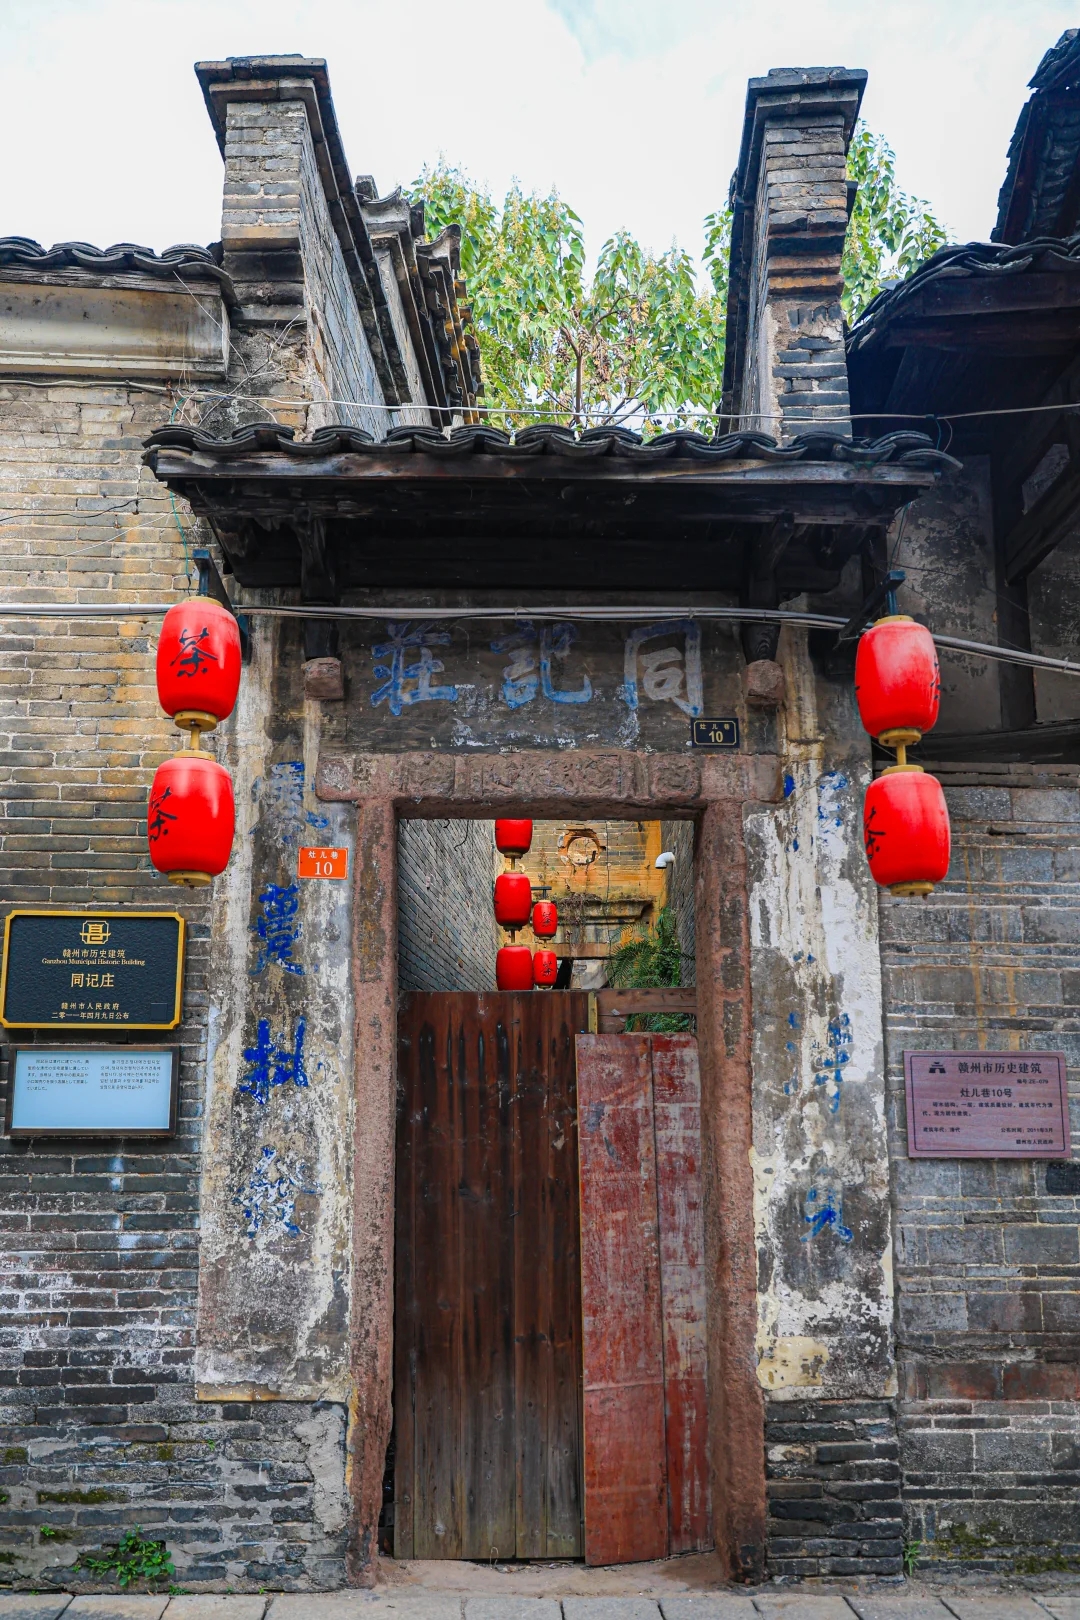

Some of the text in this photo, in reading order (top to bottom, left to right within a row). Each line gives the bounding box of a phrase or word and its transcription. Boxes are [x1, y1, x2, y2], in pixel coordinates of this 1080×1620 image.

[169, 627, 218, 678] 茶
[709, 731, 723, 742] 10
[315, 861, 333, 875] 10
[62, 948, 126, 959] 赣州市历史建筑
[68, 958, 97, 966] Municipal
[121, 959, 146, 967] Building
[70, 973, 115, 988] 同记庄
[61, 1002, 120, 1011] 赣州市人民政府
[958, 1062, 1042, 1074] 赣州市历史建筑
[960, 1088, 1013, 1098] 灶儿巷10号
